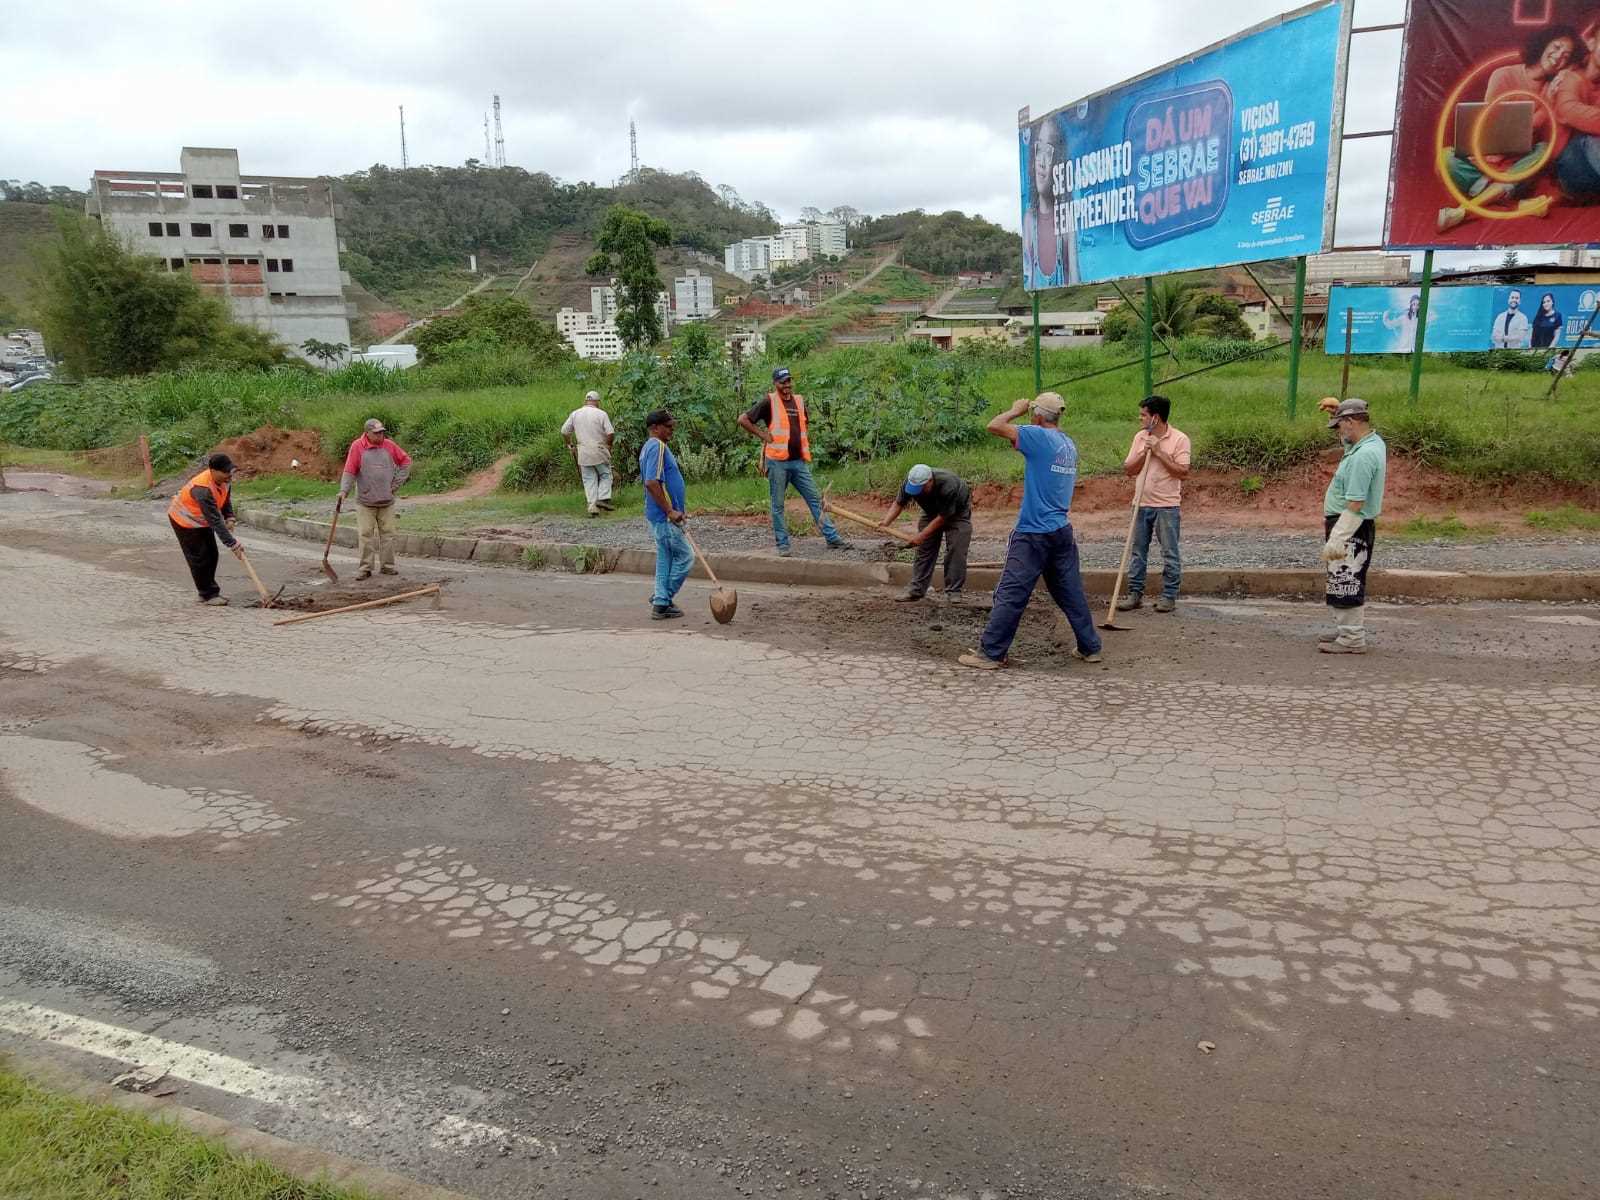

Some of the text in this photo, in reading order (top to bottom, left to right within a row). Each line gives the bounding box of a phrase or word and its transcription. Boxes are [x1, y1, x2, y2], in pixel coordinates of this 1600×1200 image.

[1145, 104, 1213, 151] DÁ UM
[1240, 136, 1258, 164] (31)
[1052, 140, 1132, 196] SE O ASSUNTO
[1137, 138, 1220, 192] SEBRAE
[1060, 184, 1139, 234] EMPREENDER,
[1138, 175, 1214, 226] QUE VAI
[1251, 204, 1296, 226] SEBRAE
